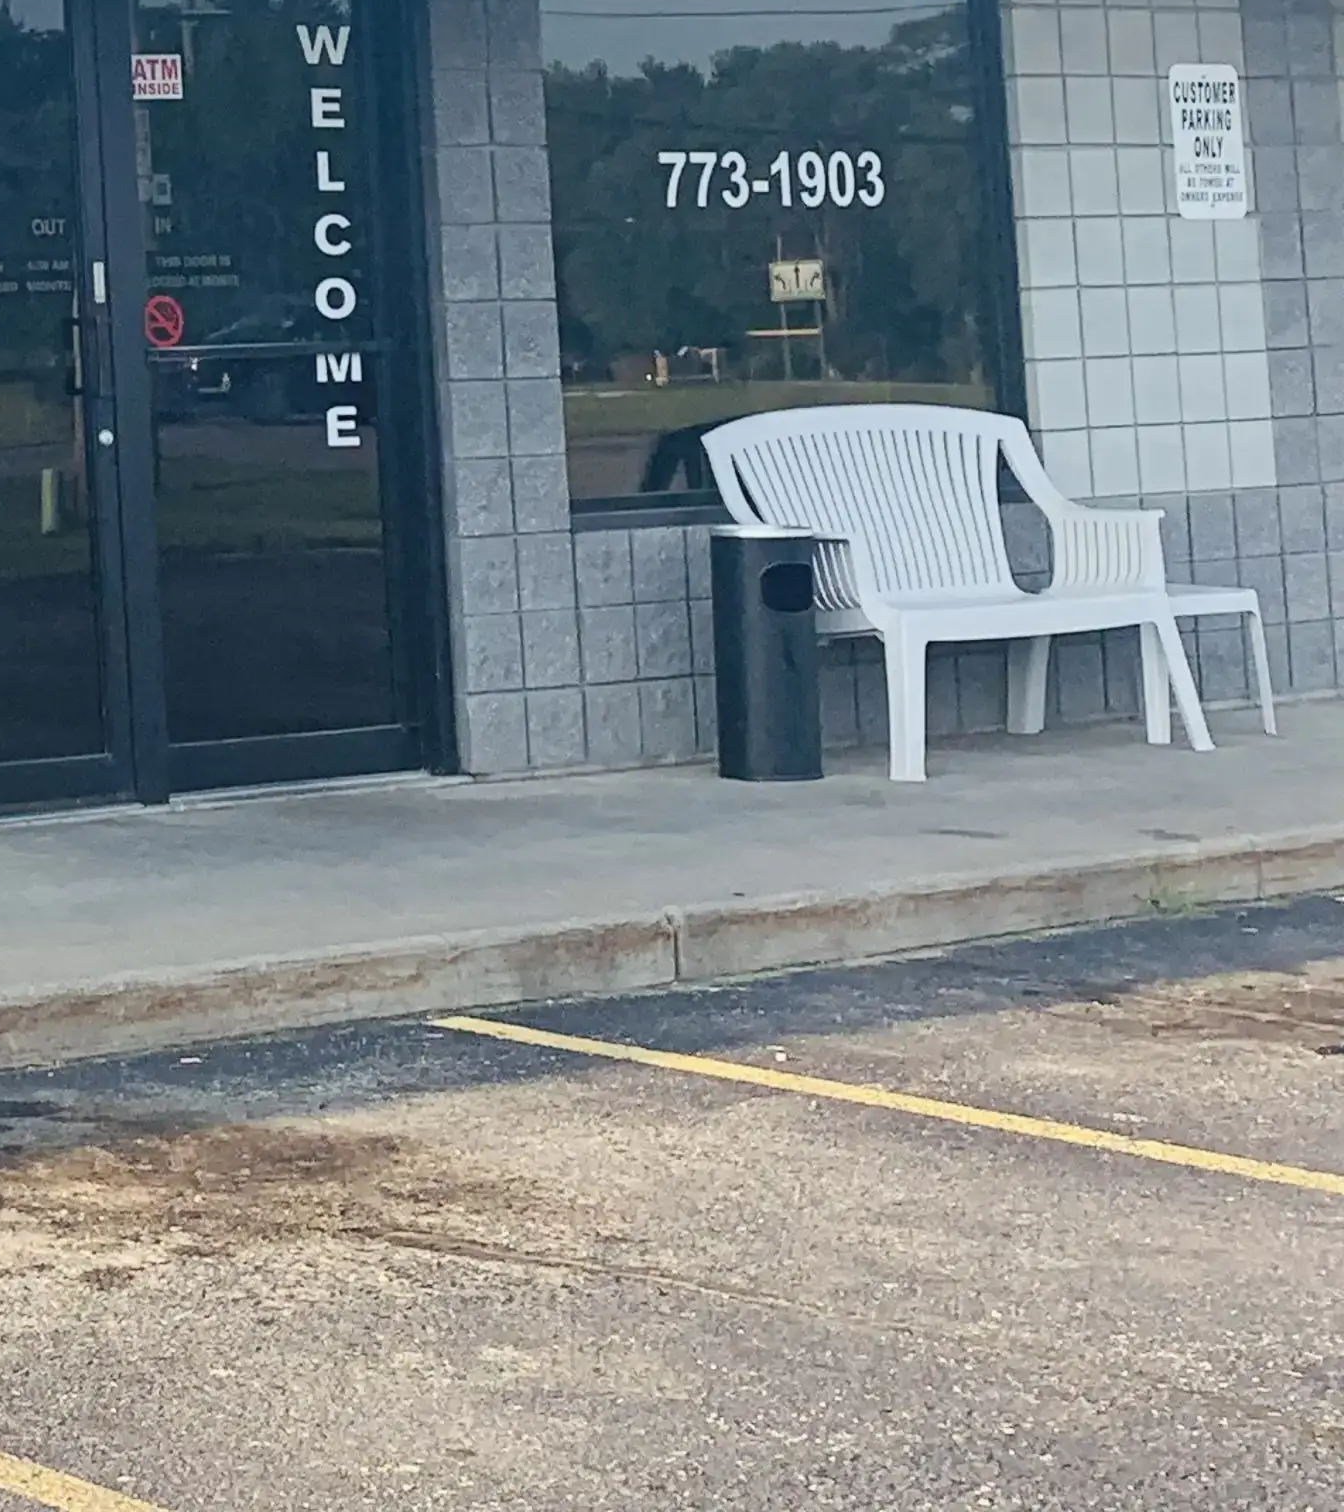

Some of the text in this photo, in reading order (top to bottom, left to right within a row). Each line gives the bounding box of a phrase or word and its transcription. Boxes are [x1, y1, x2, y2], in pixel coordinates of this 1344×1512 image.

[134, 58, 179, 81] ATM
[1172, 81, 1236, 104] CUSTOMER
[1181, 108, 1232, 131] PARKING
[1193, 136, 1224, 158] ONLY
[657, 150, 886, 209] 773-1903
[31, 217, 67, 237] OUT
[154, 216, 173, 235] IN
[296, 24, 362, 448] WELCOME
